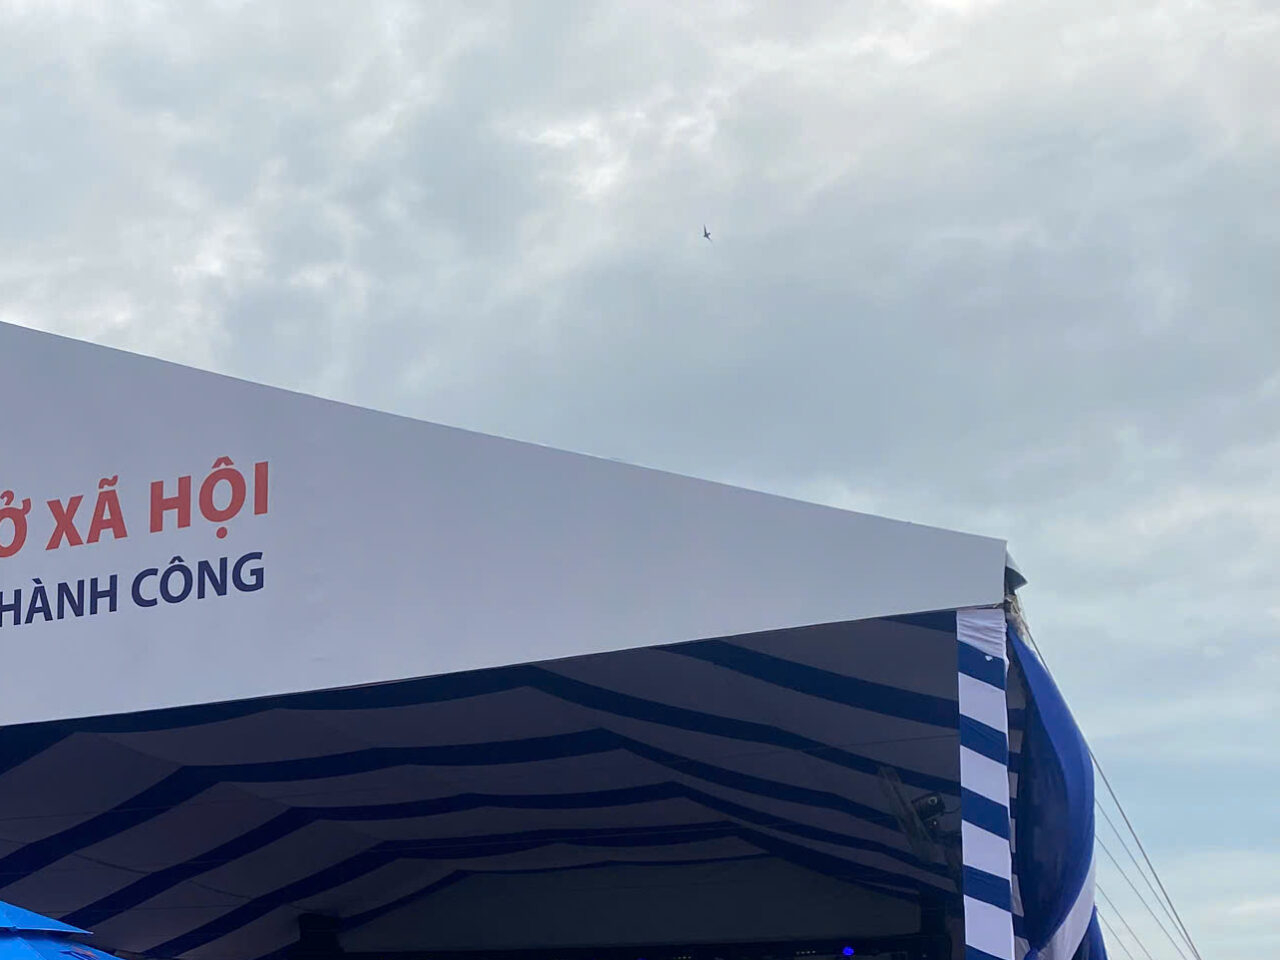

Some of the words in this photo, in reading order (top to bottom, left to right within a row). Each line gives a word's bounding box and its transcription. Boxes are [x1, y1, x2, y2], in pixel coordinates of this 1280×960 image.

[45, 475, 128, 550] XÃ
[150, 455, 269, 539] HỘI
[131, 551, 264, 607] CÔNG
